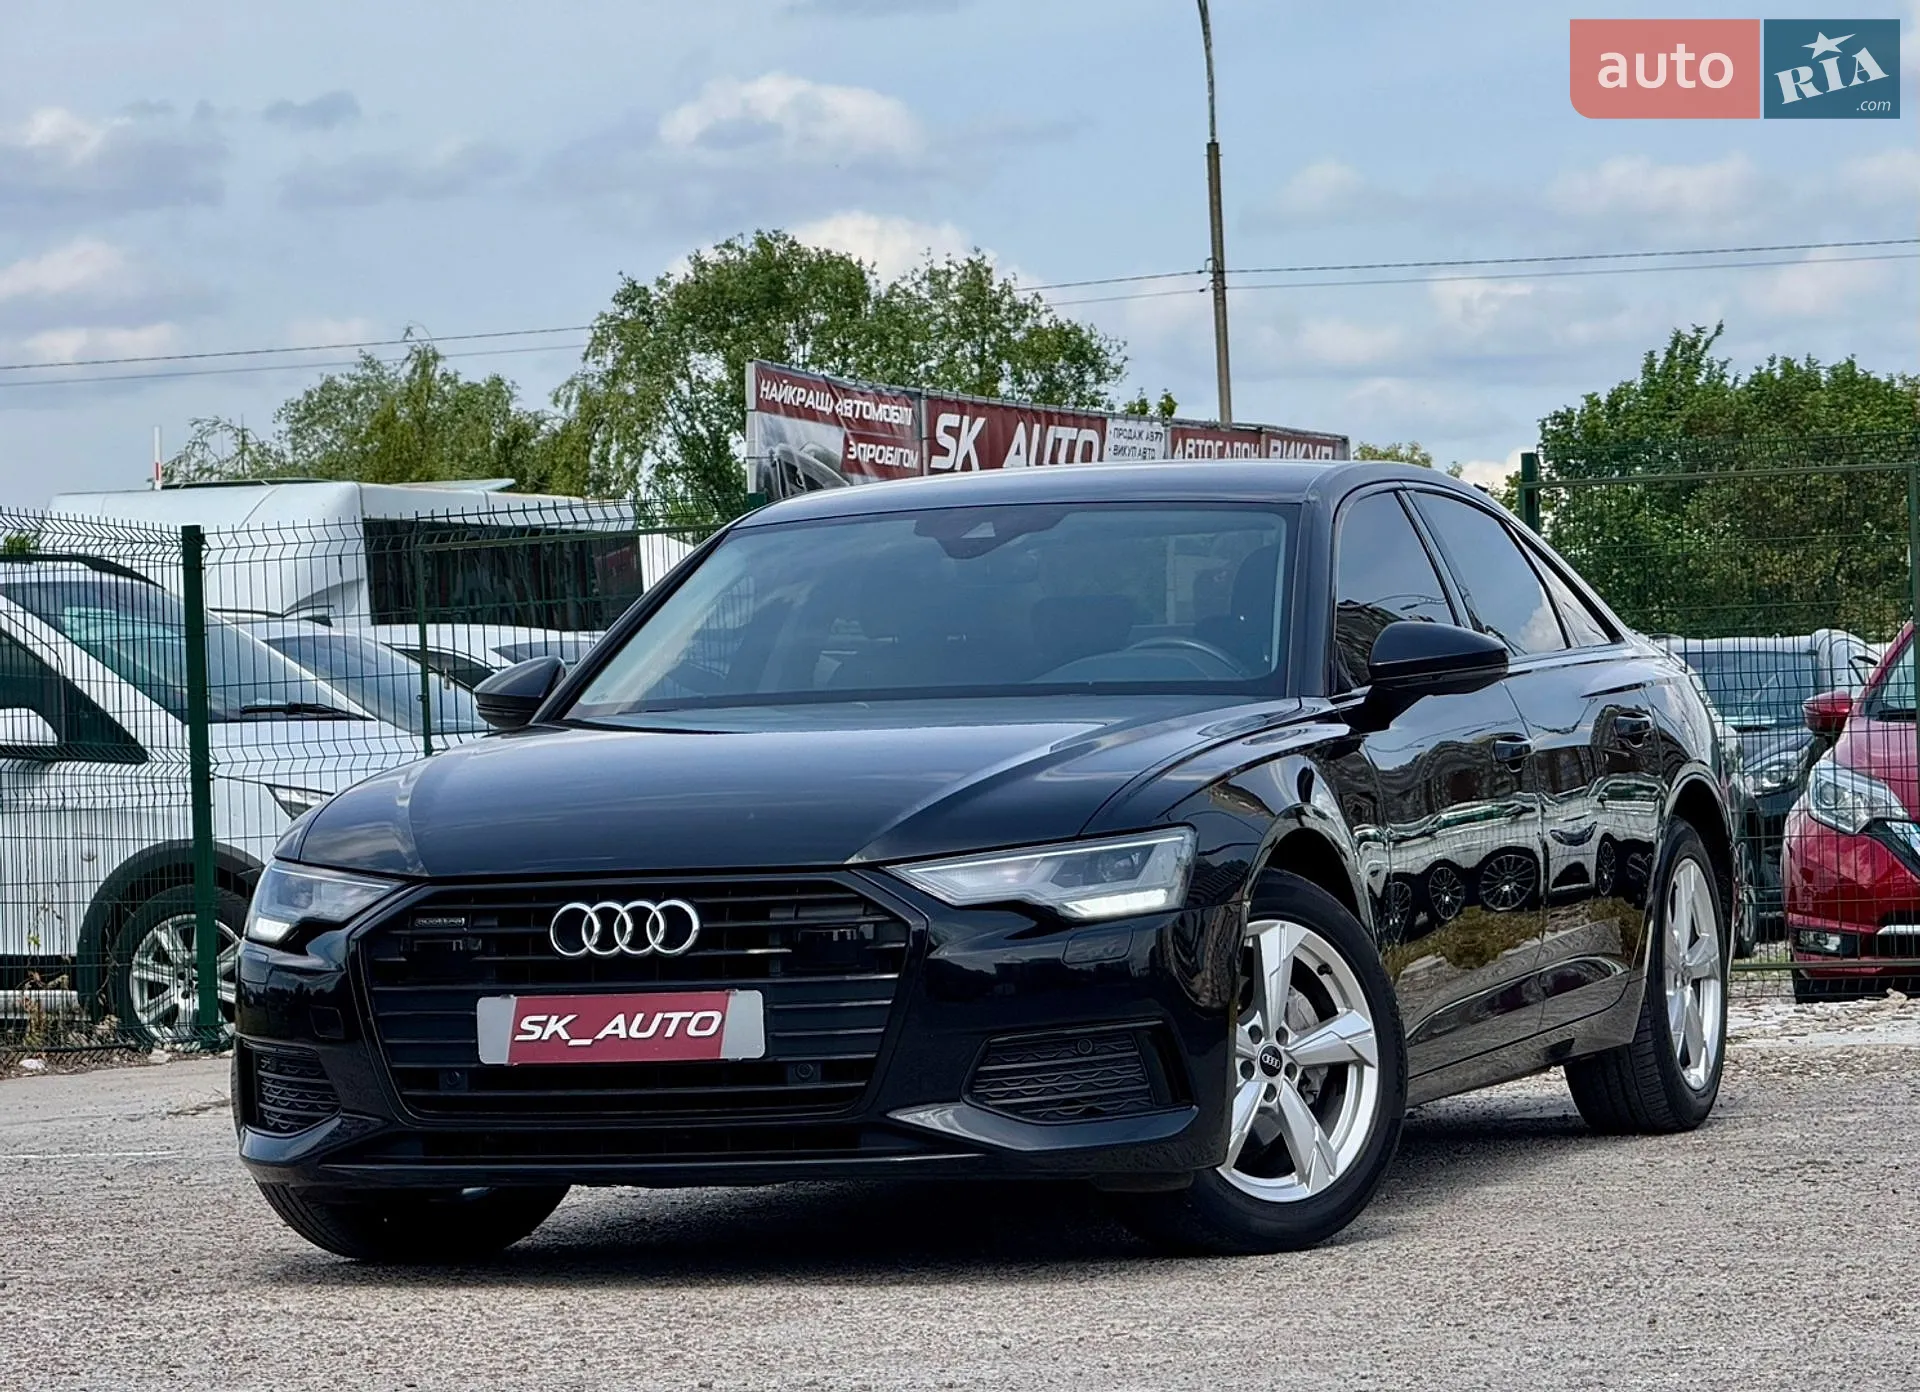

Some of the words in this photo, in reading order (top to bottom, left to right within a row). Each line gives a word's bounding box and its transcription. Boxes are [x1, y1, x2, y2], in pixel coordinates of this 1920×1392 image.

[930, 413, 986, 471] SK
[1003, 421, 1100, 468] AUTO
[513, 1009, 724, 1047] SK_AUTO
